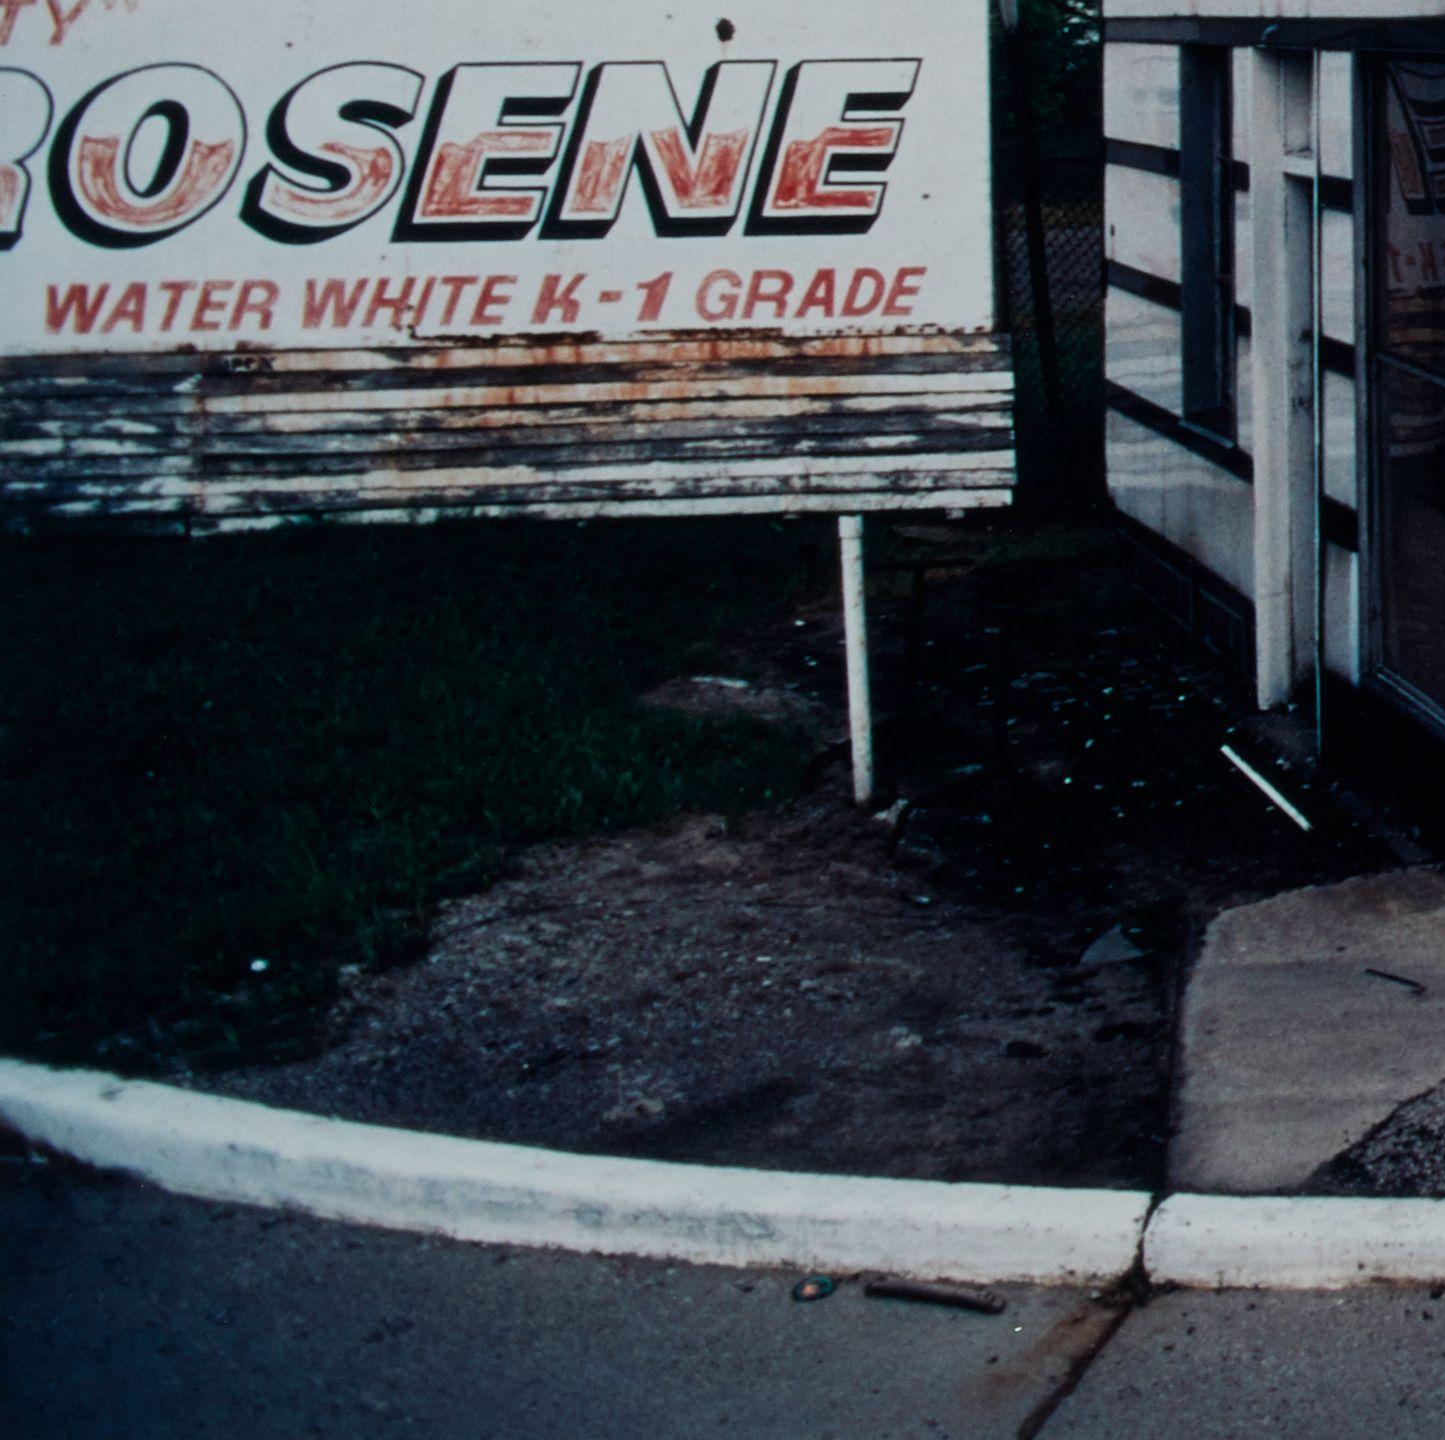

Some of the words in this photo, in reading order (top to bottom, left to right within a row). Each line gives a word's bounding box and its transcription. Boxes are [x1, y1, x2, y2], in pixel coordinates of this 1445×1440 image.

[44, 279, 280, 335] WATER
[301, 274, 518, 330] WHITE
[694, 266, 928, 322] GRADE
